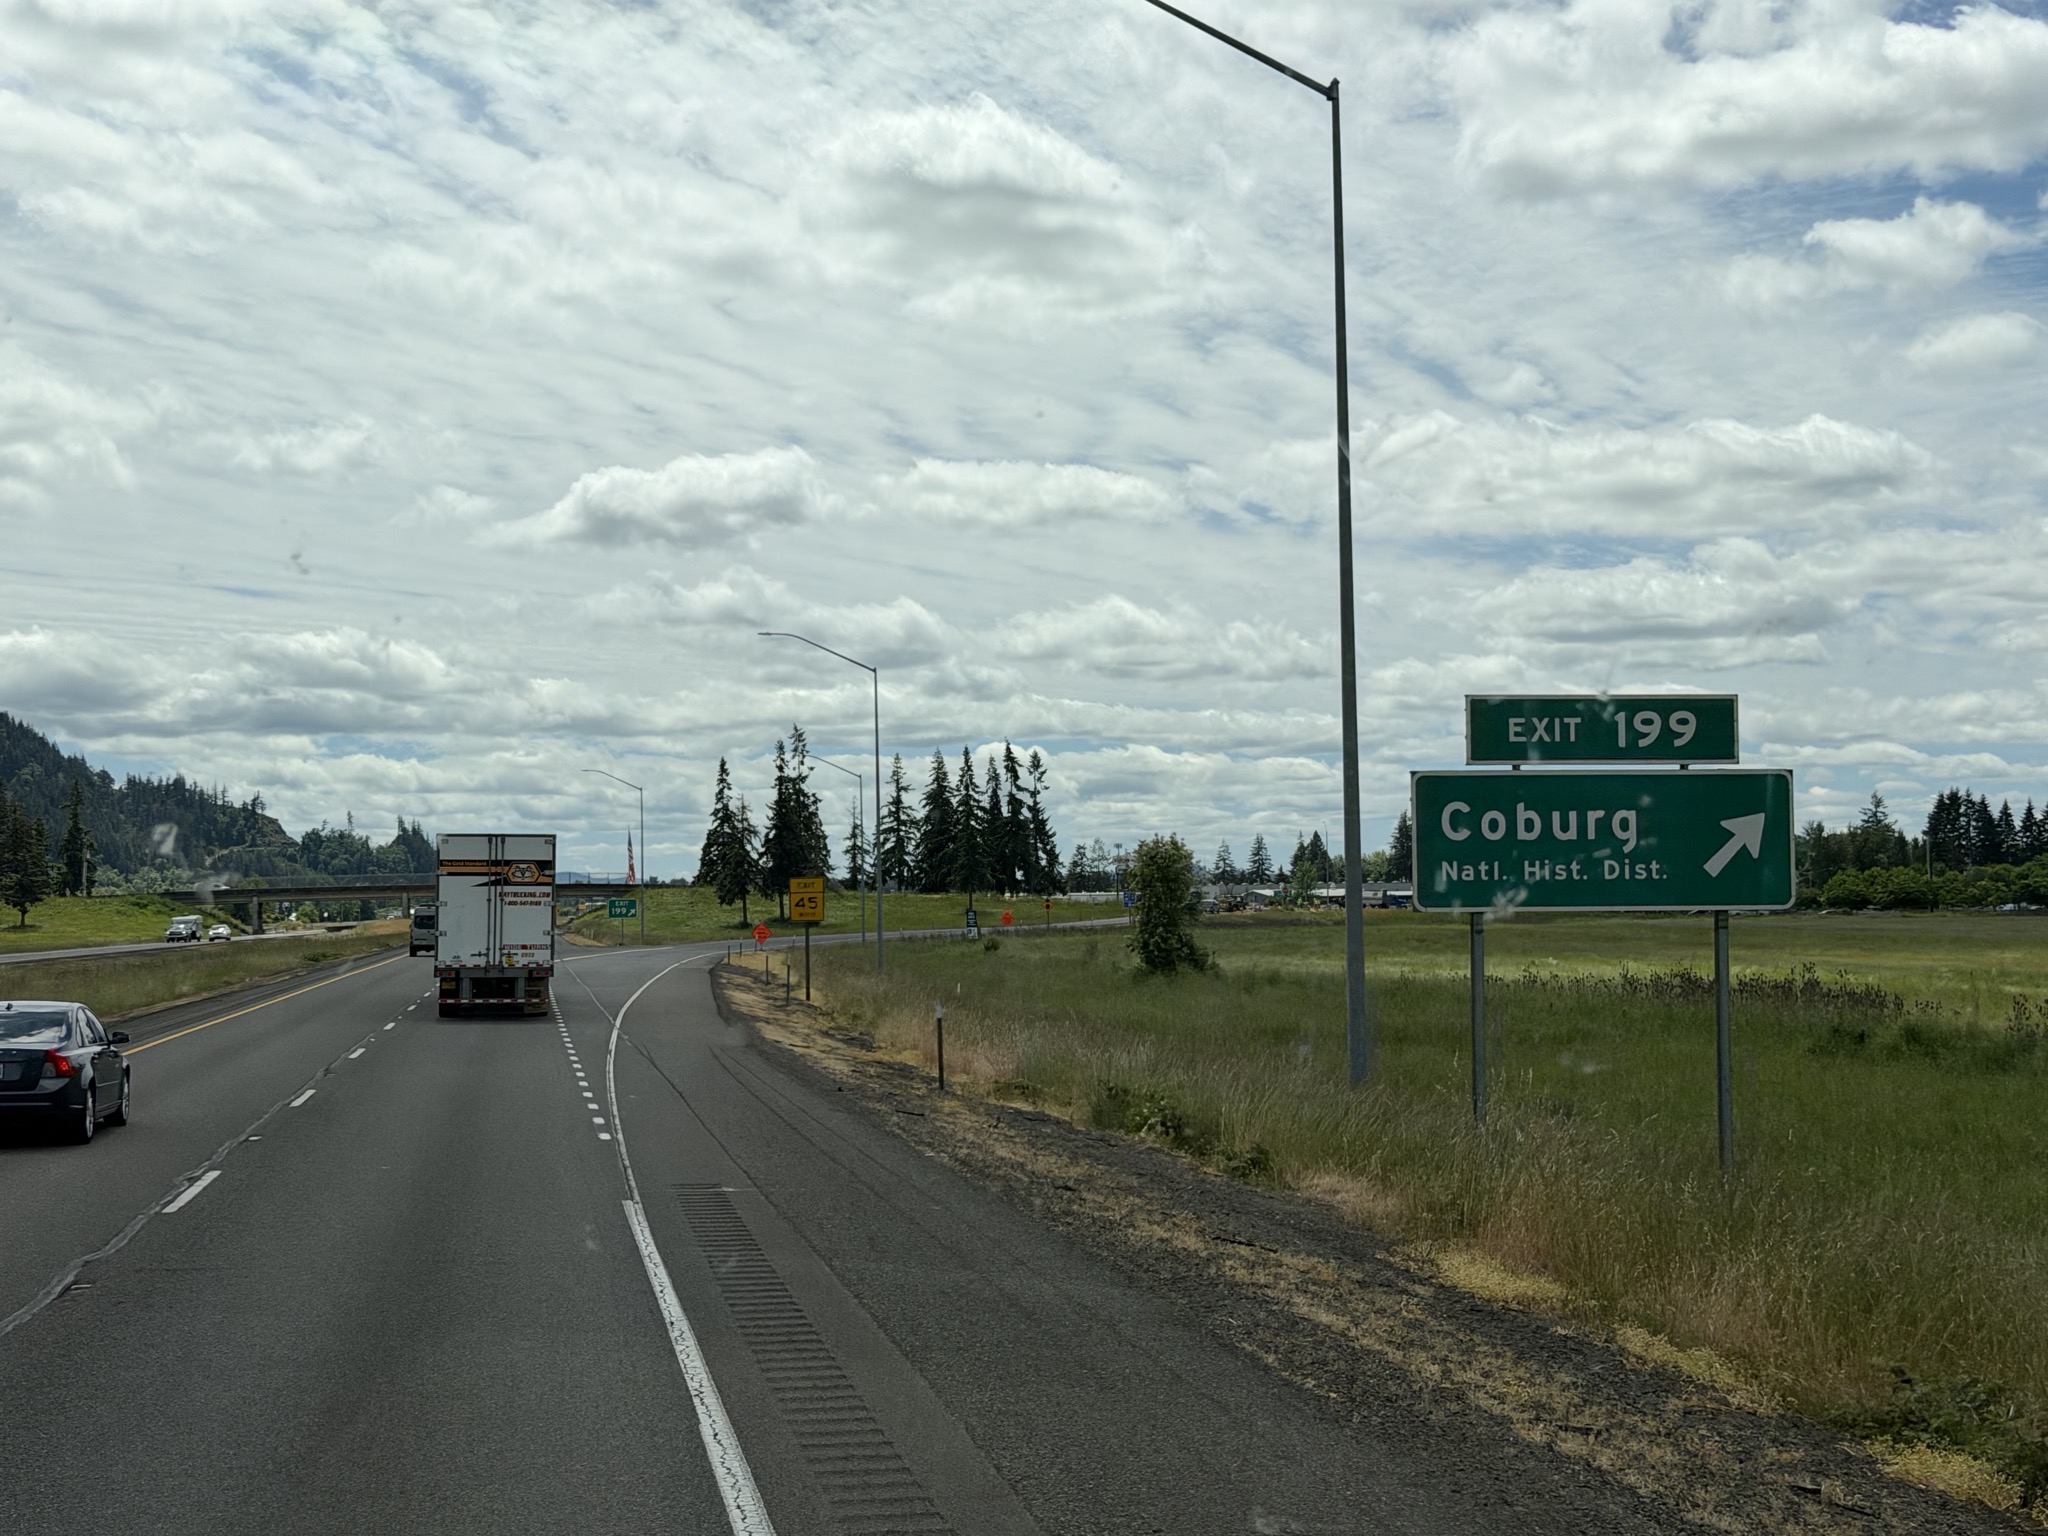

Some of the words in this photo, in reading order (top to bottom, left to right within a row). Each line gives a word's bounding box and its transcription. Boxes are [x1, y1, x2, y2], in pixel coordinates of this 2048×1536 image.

[1508, 717, 1582, 742] EXIT
[1614, 710, 1697, 747] 199
[1441, 801, 1637, 854] Coburg
[1441, 860, 1507, 881] Natl.
[1524, 860, 1588, 881] Hist.
[1604, 859, 1667, 881] Dist.
[612, 907, 627, 915] 199
[794, 896, 818, 909] 45
